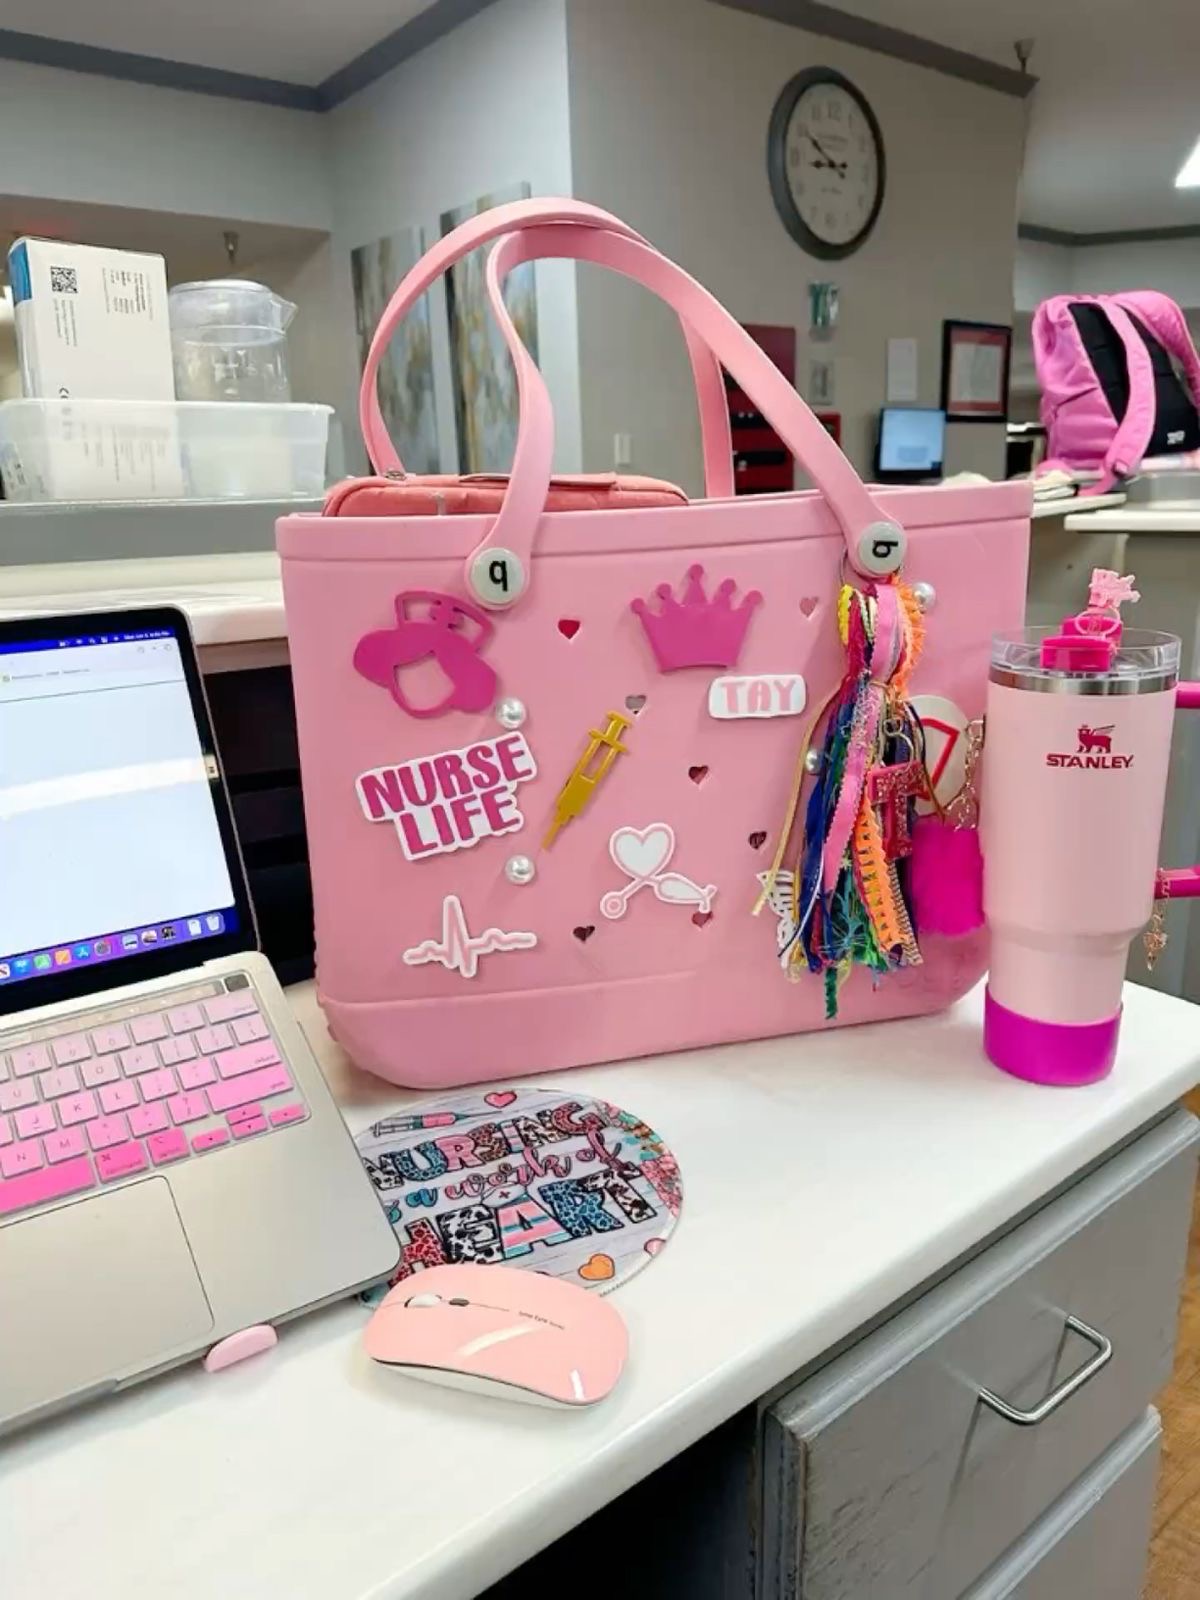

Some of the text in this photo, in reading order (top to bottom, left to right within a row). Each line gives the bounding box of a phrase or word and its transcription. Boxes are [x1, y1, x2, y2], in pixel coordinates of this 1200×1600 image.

[719, 680, 797, 713] TAY
[360, 735, 533, 819] NURSE
[1046, 754, 1134, 768] STANLEY
[400, 785, 520, 855] LIFE
[362, 1101, 607, 1191] NURSING
[405, 1188, 439, 1208] a
[444, 1146, 571, 1200] work
